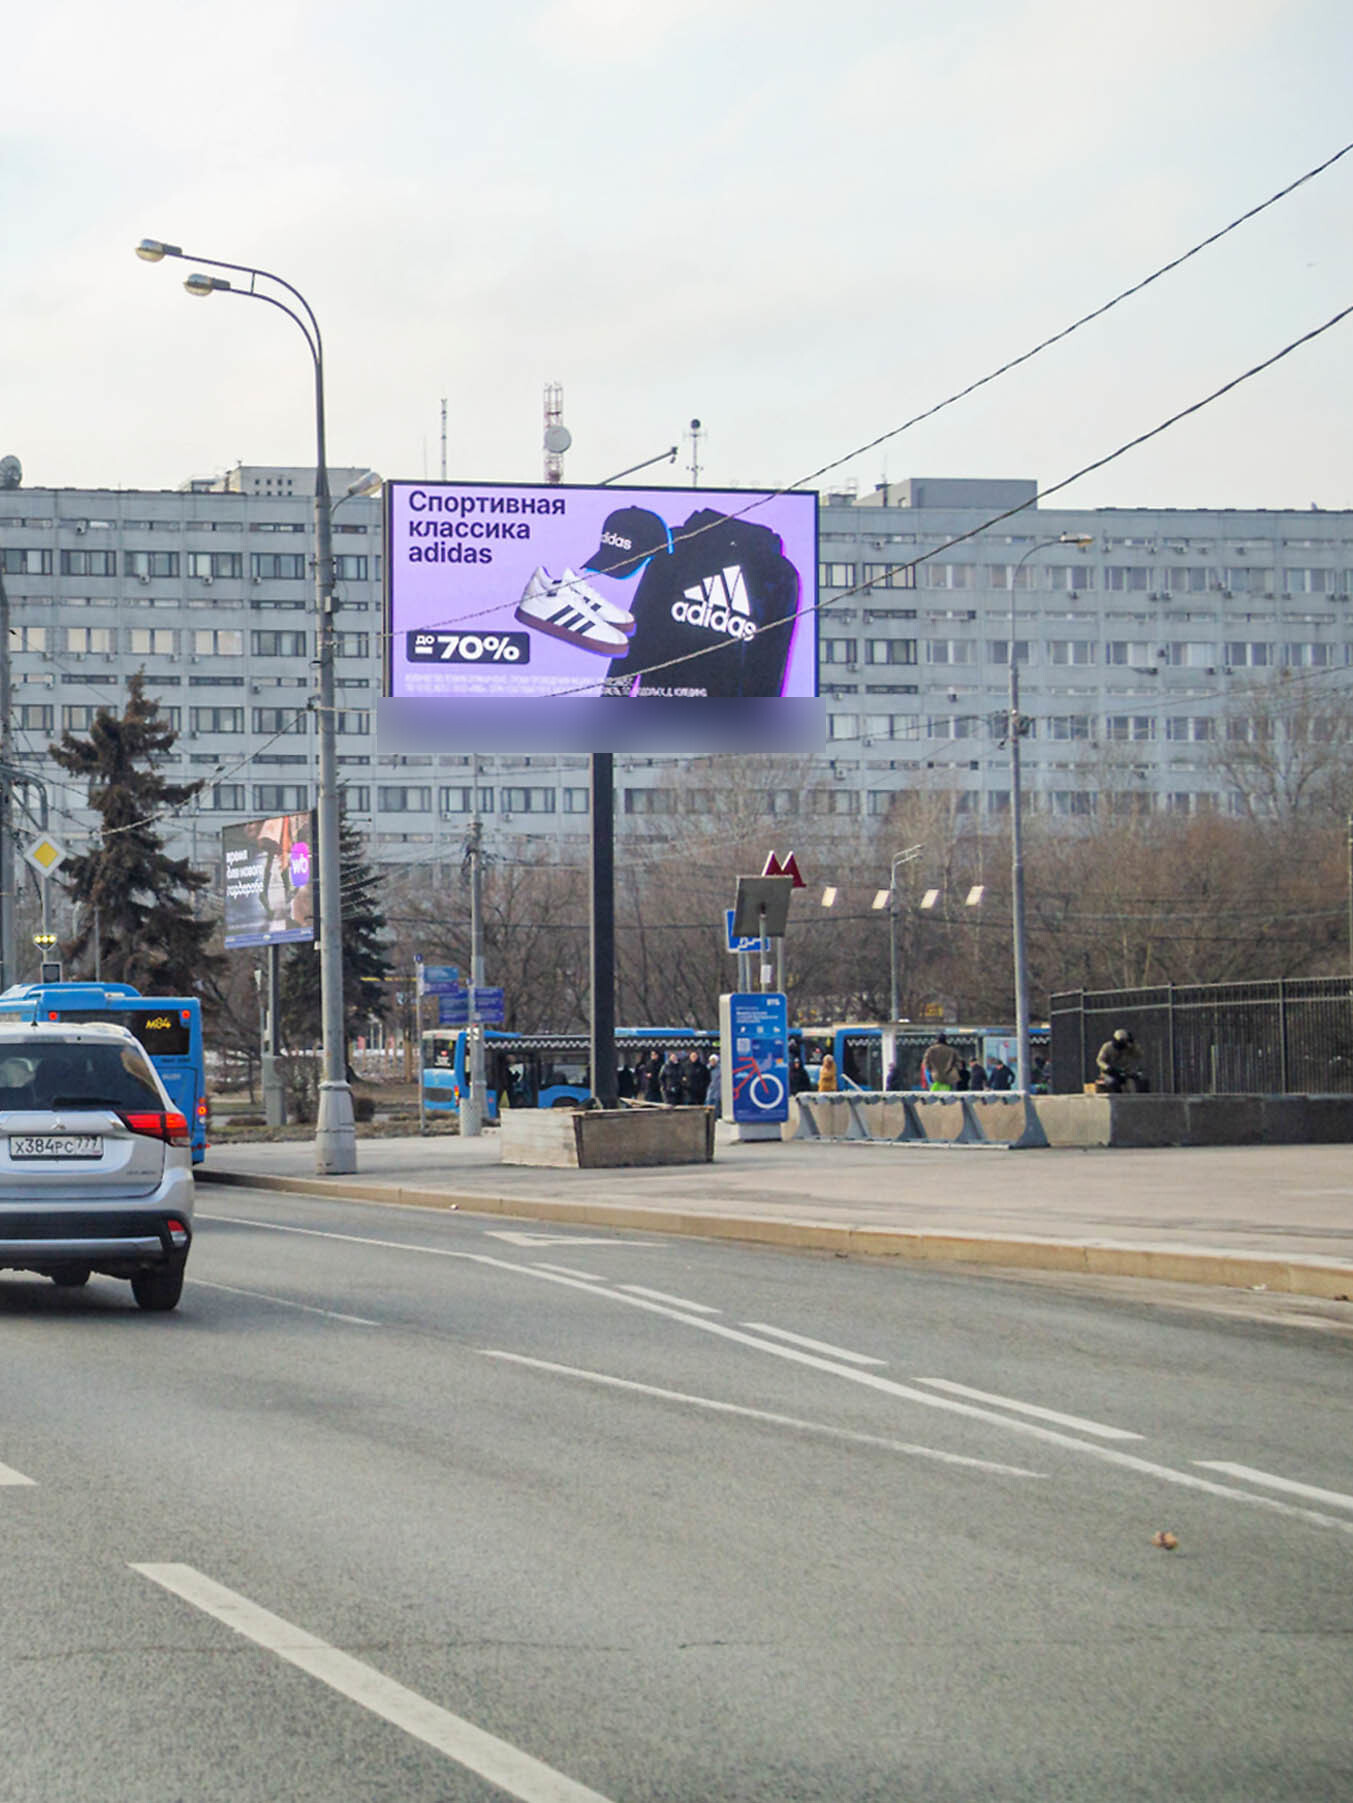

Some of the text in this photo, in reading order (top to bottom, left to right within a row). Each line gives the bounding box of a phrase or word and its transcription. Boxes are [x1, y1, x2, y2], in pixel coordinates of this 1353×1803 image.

[408, 490, 566, 518] Спортивная
[408, 520, 531, 540] классика
[408, 541, 493, 564] adidas
[670, 599, 757, 642] adidas
